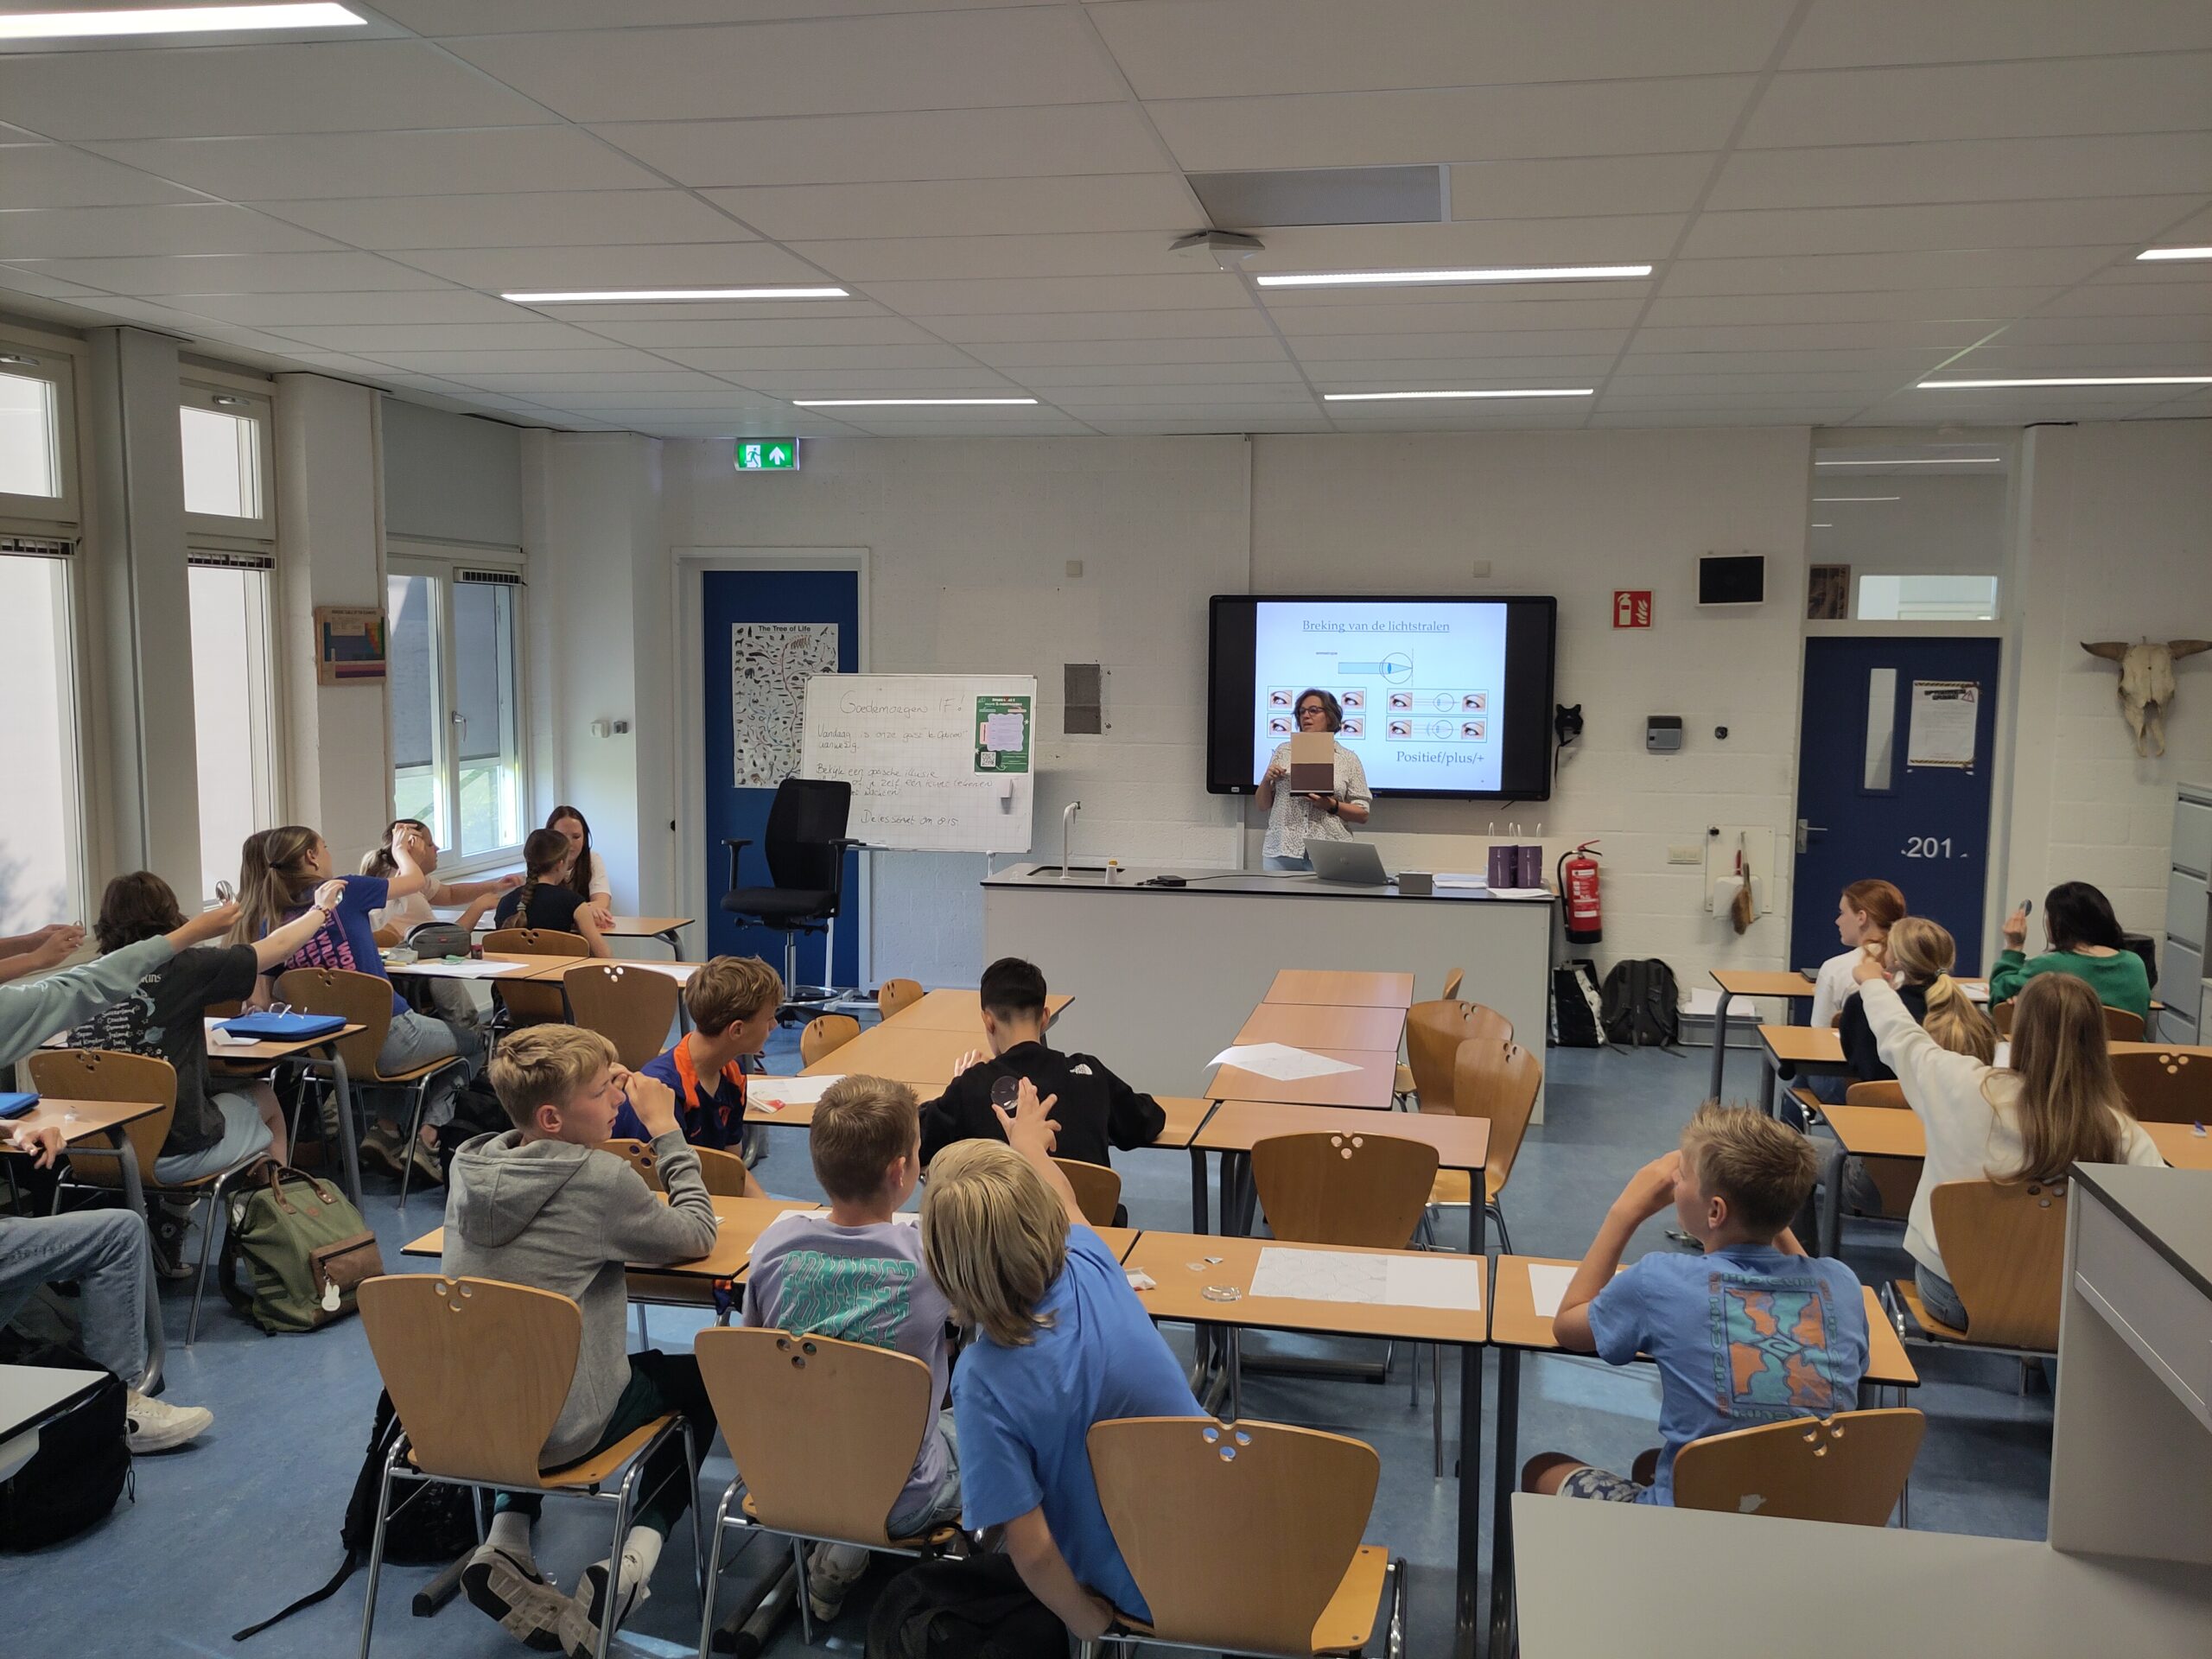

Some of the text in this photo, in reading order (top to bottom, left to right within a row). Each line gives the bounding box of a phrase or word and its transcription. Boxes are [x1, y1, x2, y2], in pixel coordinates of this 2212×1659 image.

[1302, 620, 1345, 632] Breking
[1371, 620, 1386, 631] de
[1389, 620, 1450, 632] lichtstralen
[1396, 751, 1484, 766] Positief/plus/+
[1907, 836, 1952, 858] 201
[781, 1249, 918, 1300] CONNECT
